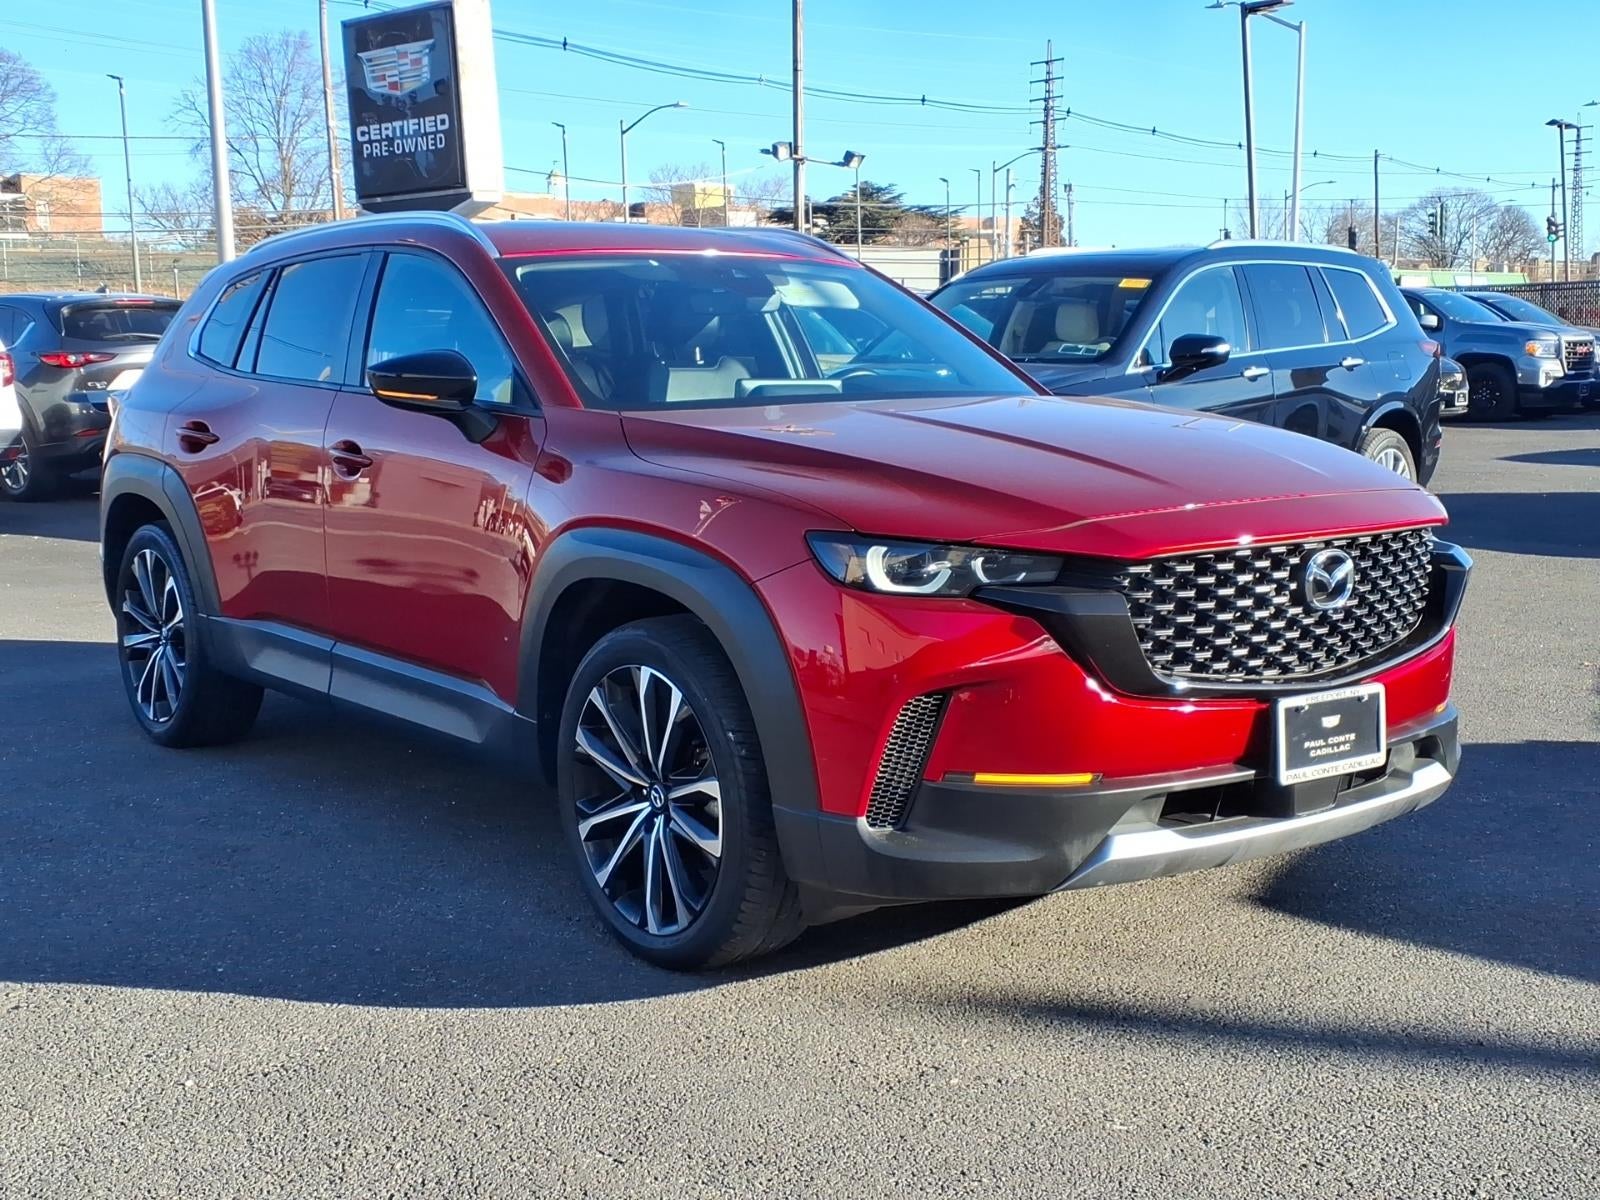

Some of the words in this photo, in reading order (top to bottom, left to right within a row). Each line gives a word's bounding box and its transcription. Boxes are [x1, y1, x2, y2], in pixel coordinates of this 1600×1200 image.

[356, 113, 450, 142] CERTIFIED
[363, 133, 445, 158] PRE-OWNED
[1304, 739, 1326, 749] PAUL
[1327, 733, 1356, 744] CONTE
[1310, 743, 1351, 757] CADILLAC
[1286, 773, 1309, 782] PAUL
[1311, 765, 1340, 777] CONTE
[1342, 757, 1382, 771] CADILLAC
